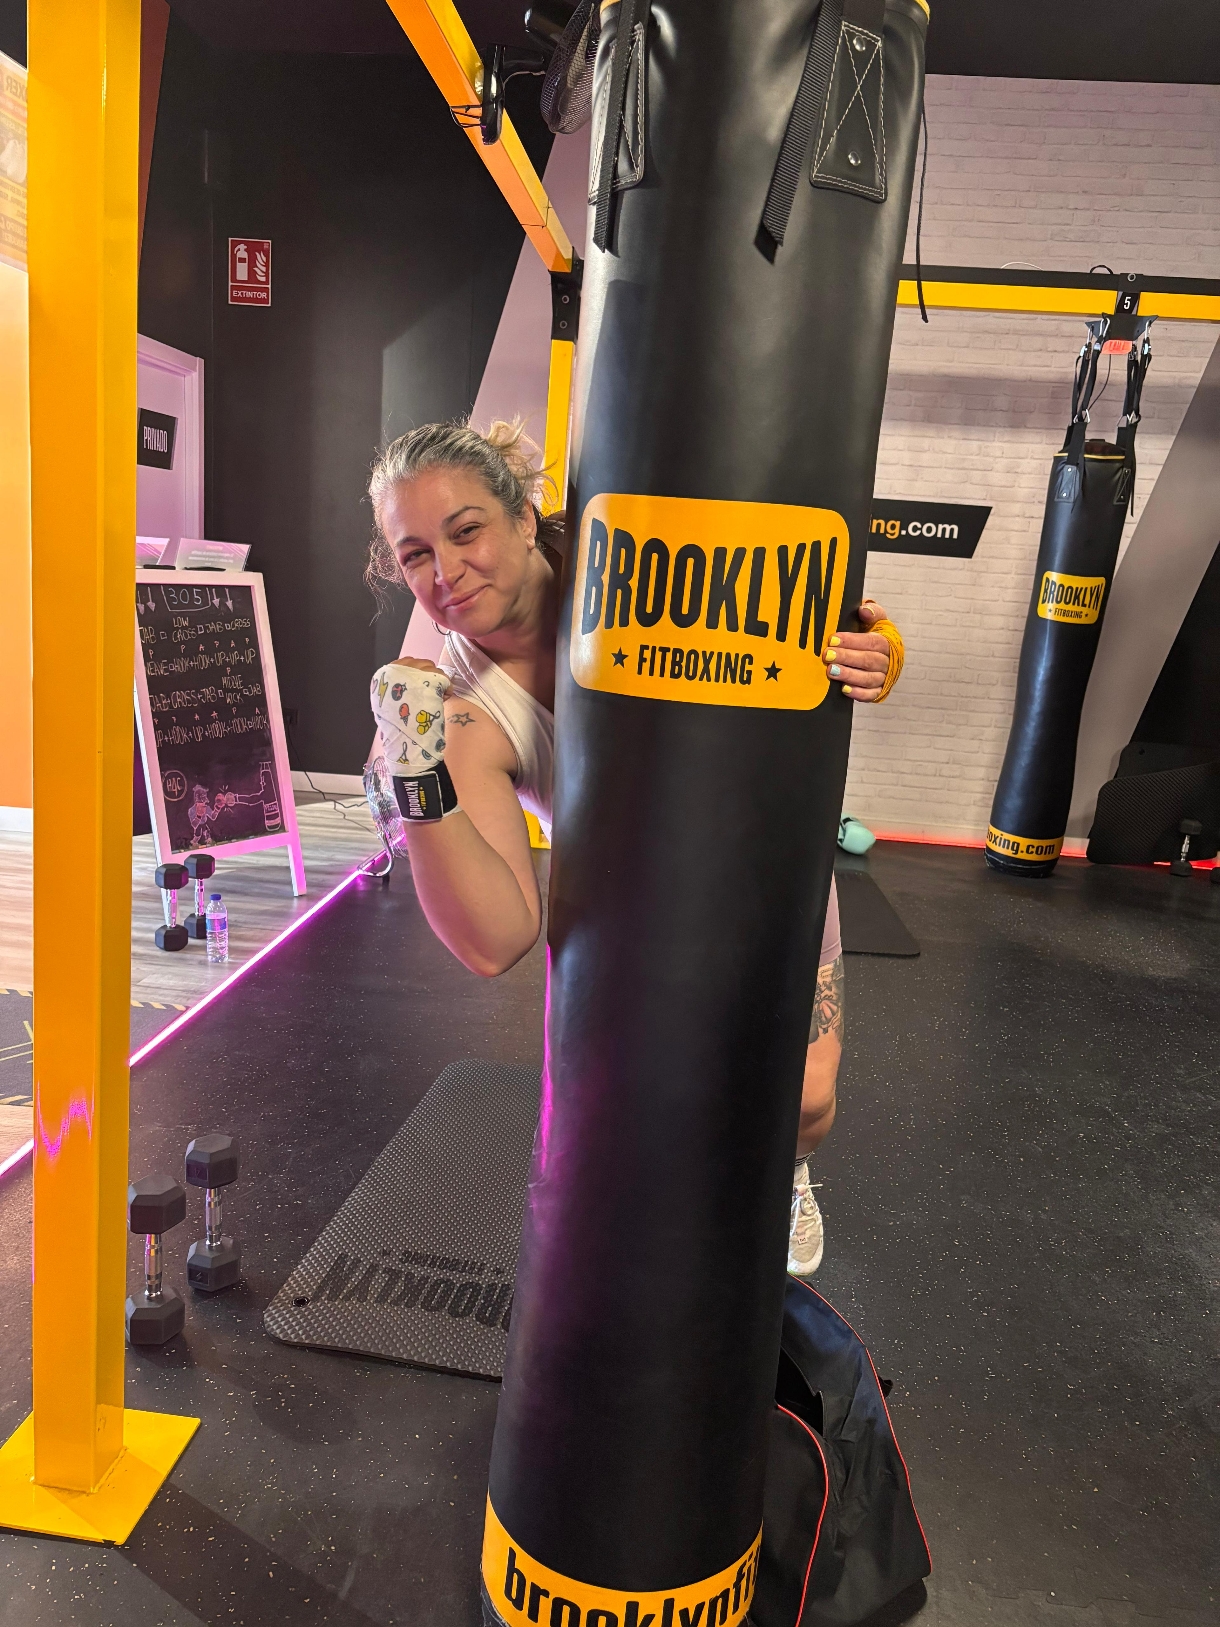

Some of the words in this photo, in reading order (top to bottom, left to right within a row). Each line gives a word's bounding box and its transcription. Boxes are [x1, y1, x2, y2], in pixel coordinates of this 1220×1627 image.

[232, 290, 268, 299] EXTINTOR
[1123, 296, 1132, 310] 5
[143, 425, 168, 453] PRIVADO
[869, 515, 959, 539] ng.com
[581, 517, 838, 657] BROOKLYN
[1041, 576, 1103, 611] BROOKLYN
[172, 617, 188, 627] LOW
[1054, 607, 1083, 619] FITBOXING
[636, 644, 754, 685] FITBOXING
[403, 781, 424, 816] BROOKLYN
